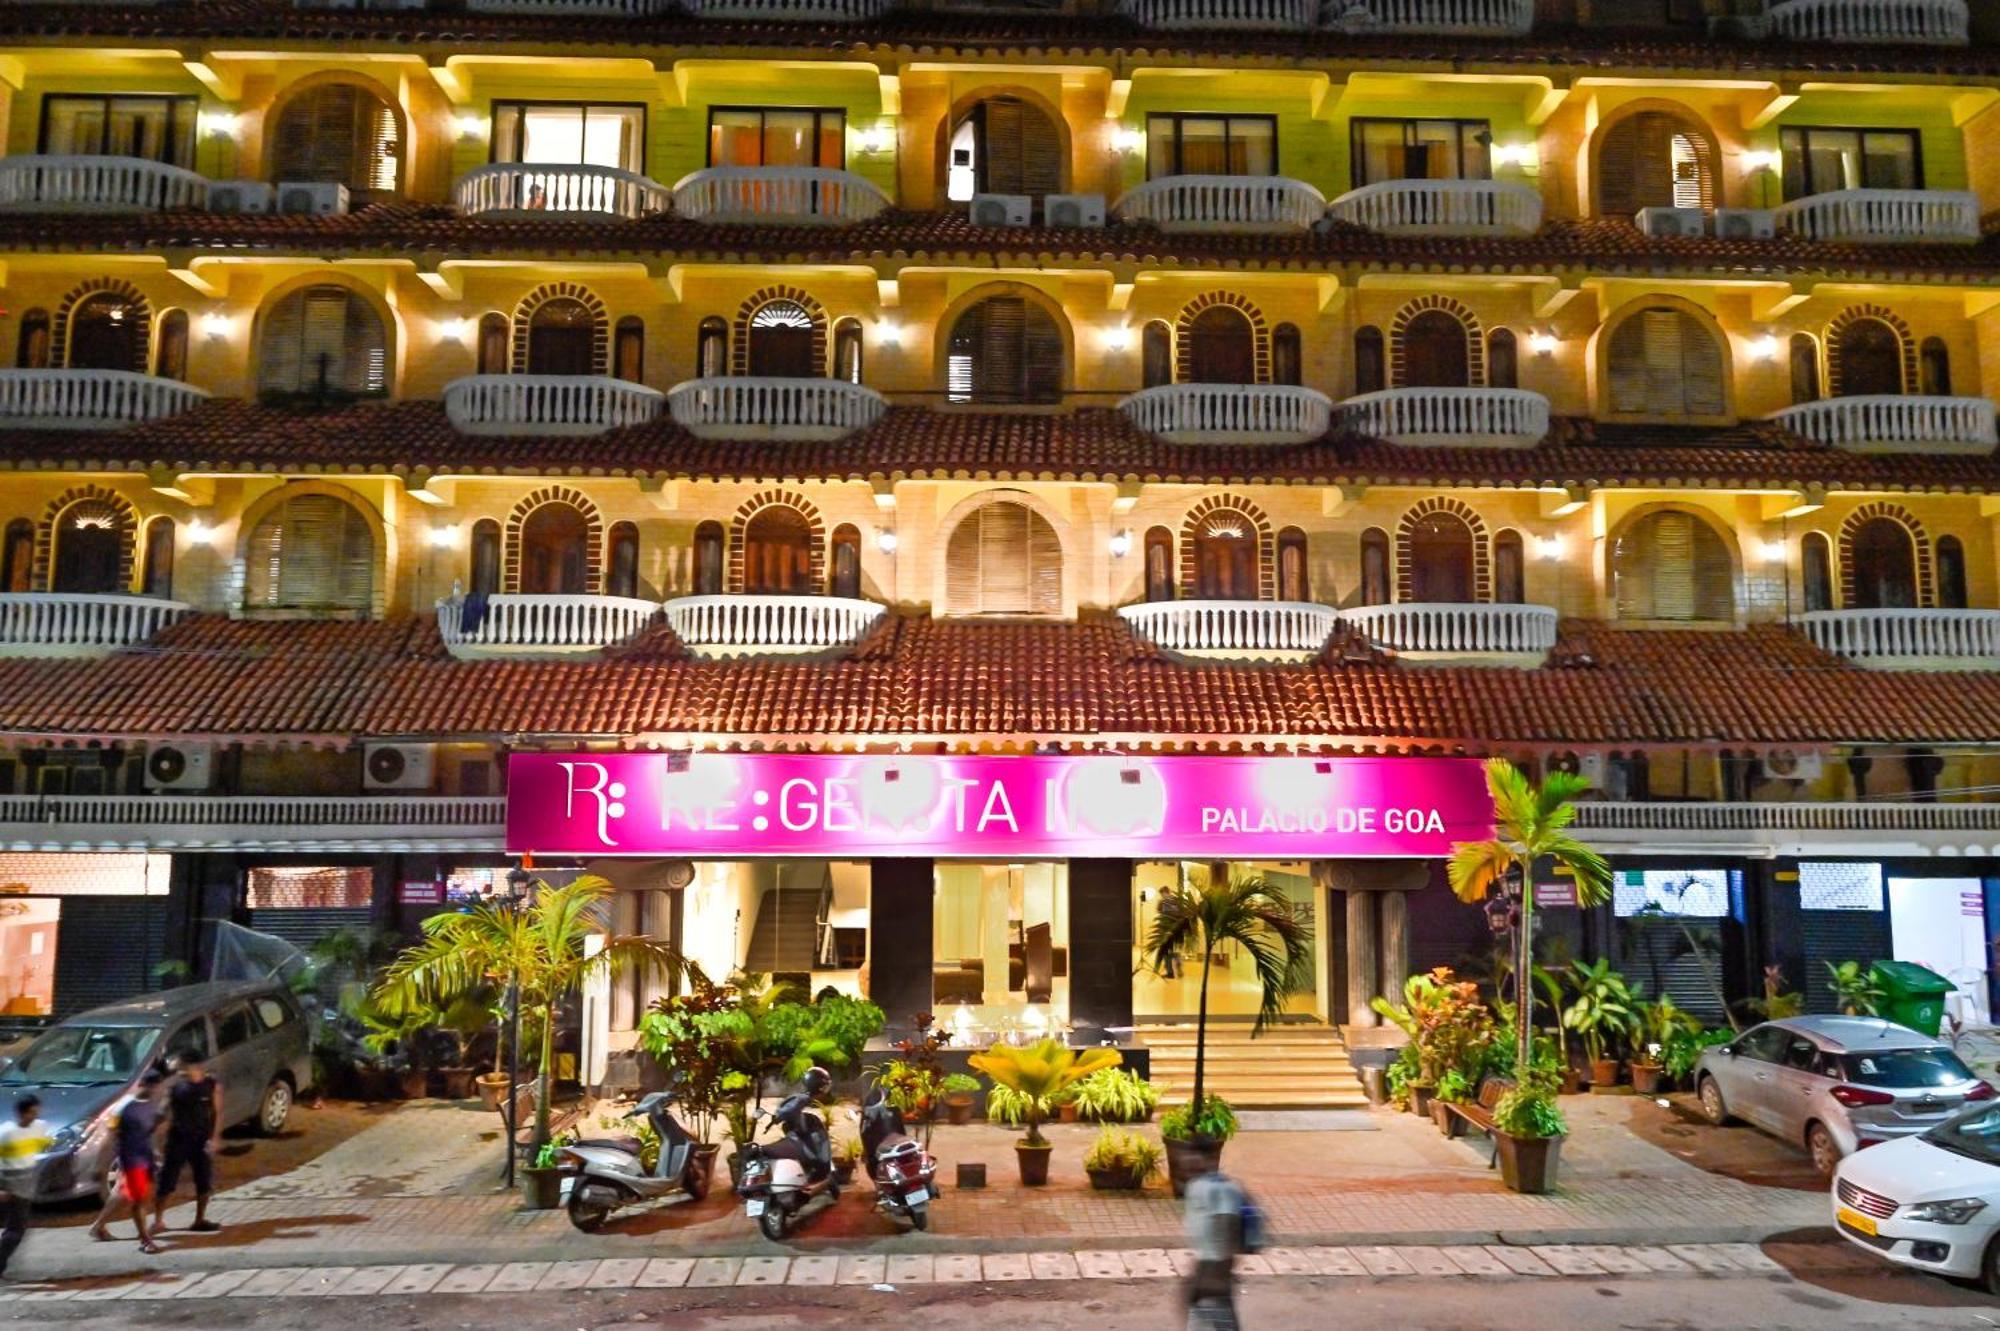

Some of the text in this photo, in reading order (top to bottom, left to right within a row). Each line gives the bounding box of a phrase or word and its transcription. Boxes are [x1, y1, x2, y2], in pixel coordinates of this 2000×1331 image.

[1201, 806, 1446, 834] PALACIO DE GOA
